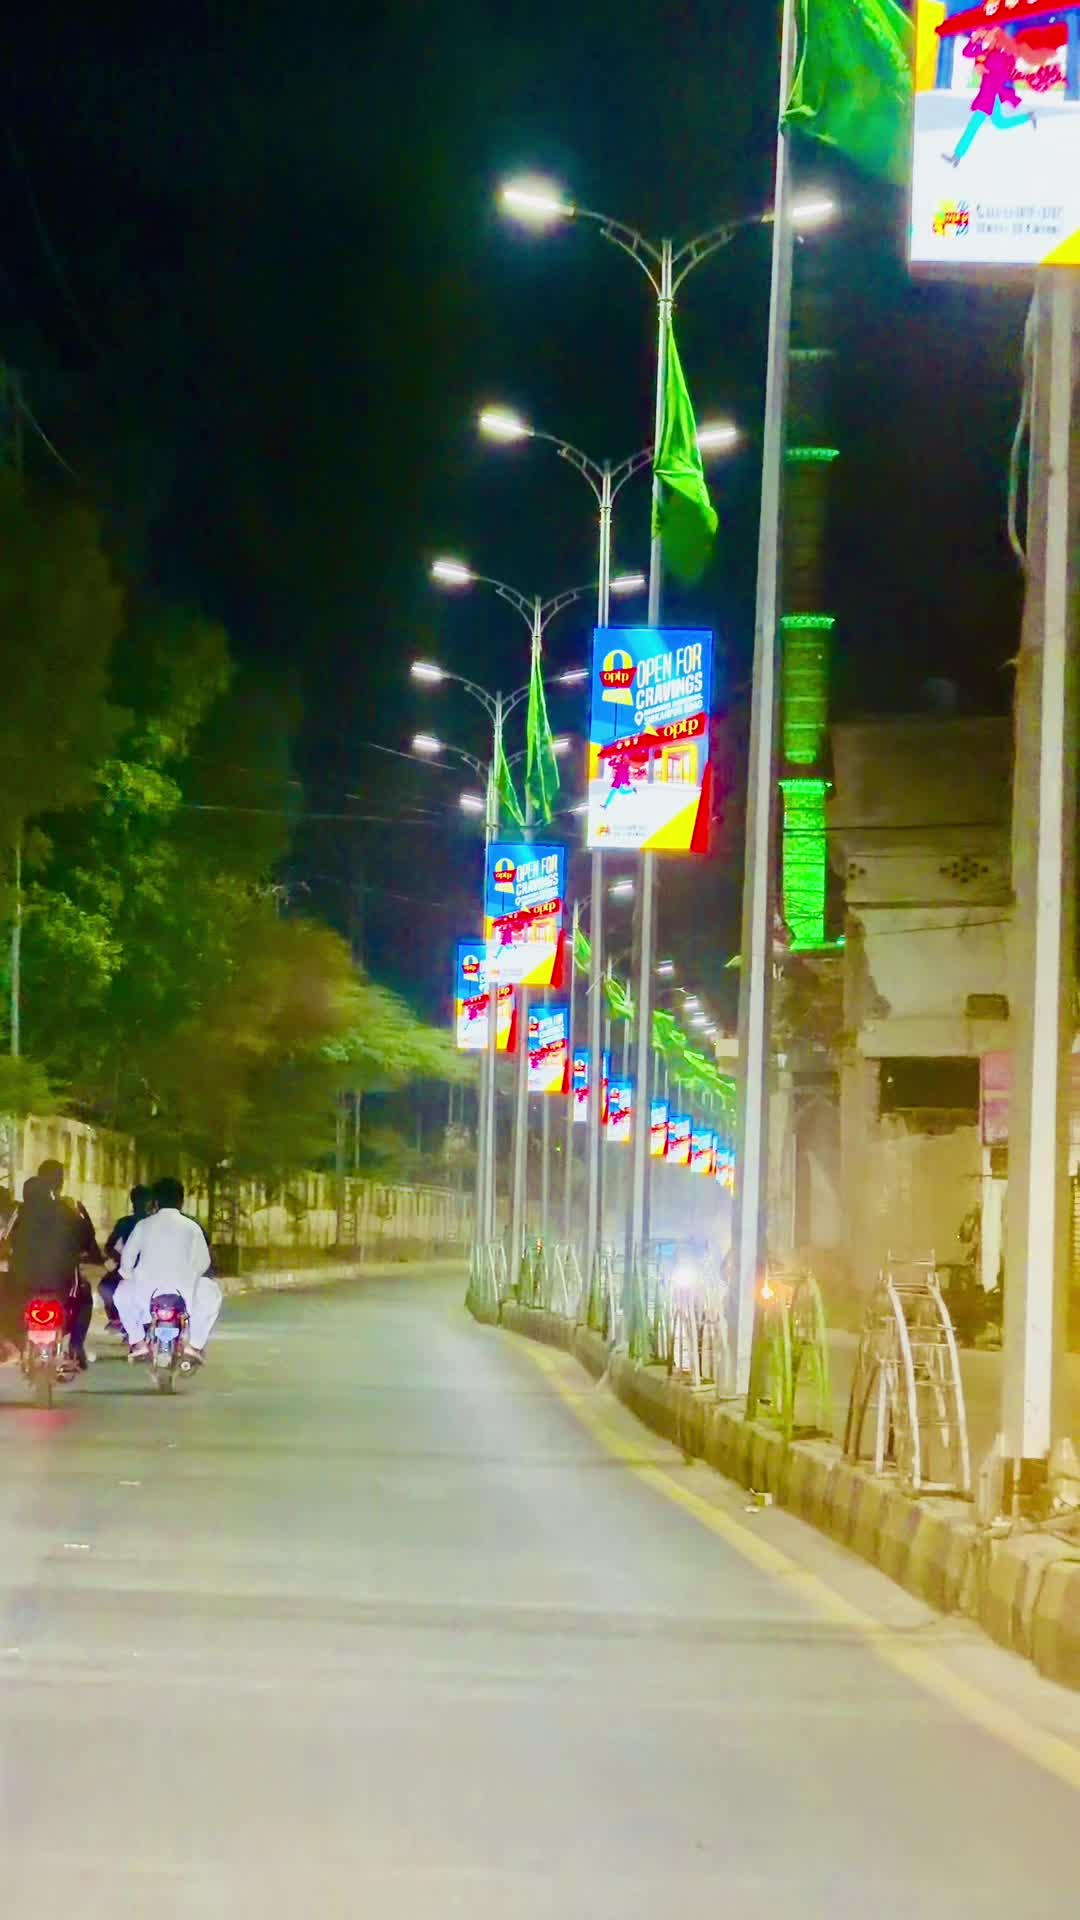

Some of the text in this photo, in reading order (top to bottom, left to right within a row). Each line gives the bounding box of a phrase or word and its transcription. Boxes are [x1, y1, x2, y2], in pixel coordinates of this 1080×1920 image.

[603, 671, 630, 684] optp
[637, 642, 702, 688] OPEN FOR
[635, 671, 703, 710] CRAVINGS
[663, 718, 699, 739] optp
[516, 854, 558, 883] OPEN FOR
[533, 901, 557, 915] optp
